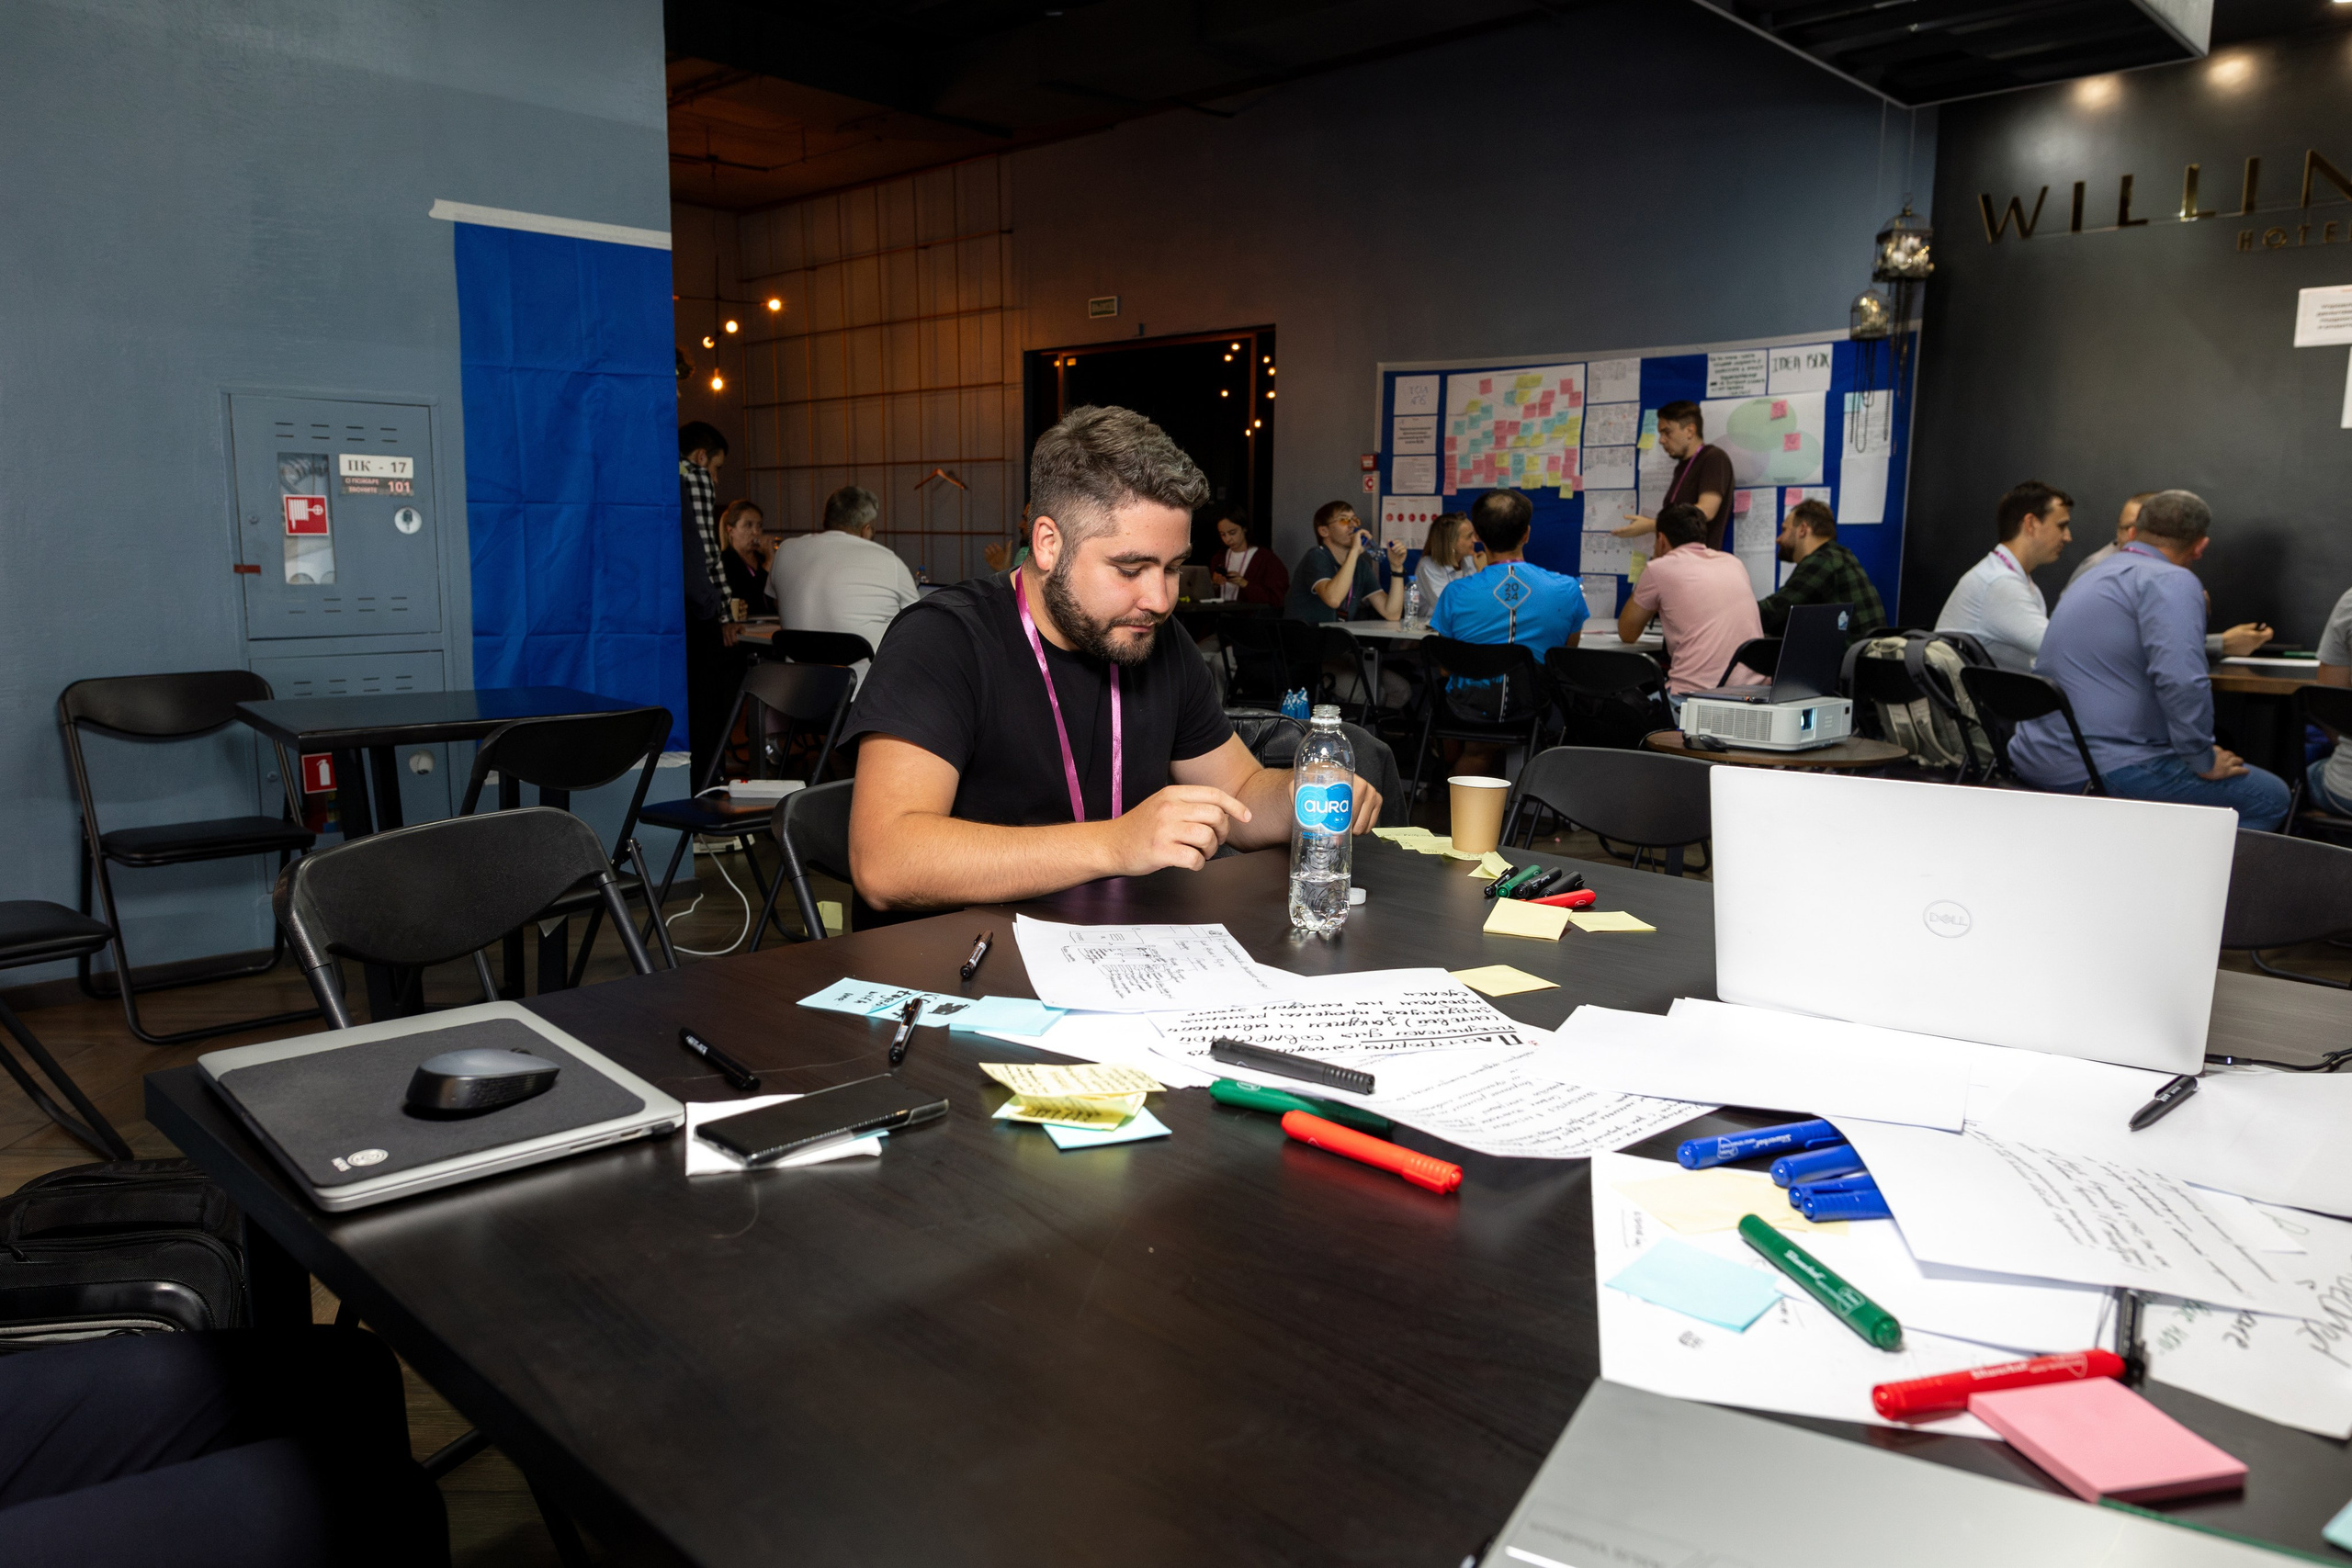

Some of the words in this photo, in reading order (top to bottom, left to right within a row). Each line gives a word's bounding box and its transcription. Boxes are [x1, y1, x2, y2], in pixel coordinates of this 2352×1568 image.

[2237, 220, 2352, 252] HOTE
[348, 459, 371, 472] ПК
[390, 462, 407, 473] 17
[388, 480, 411, 494] 101
[1504, 582, 1520, 592] 20
[1504, 592, 1519, 602] 24
[1929, 911, 1968, 927] DELL
